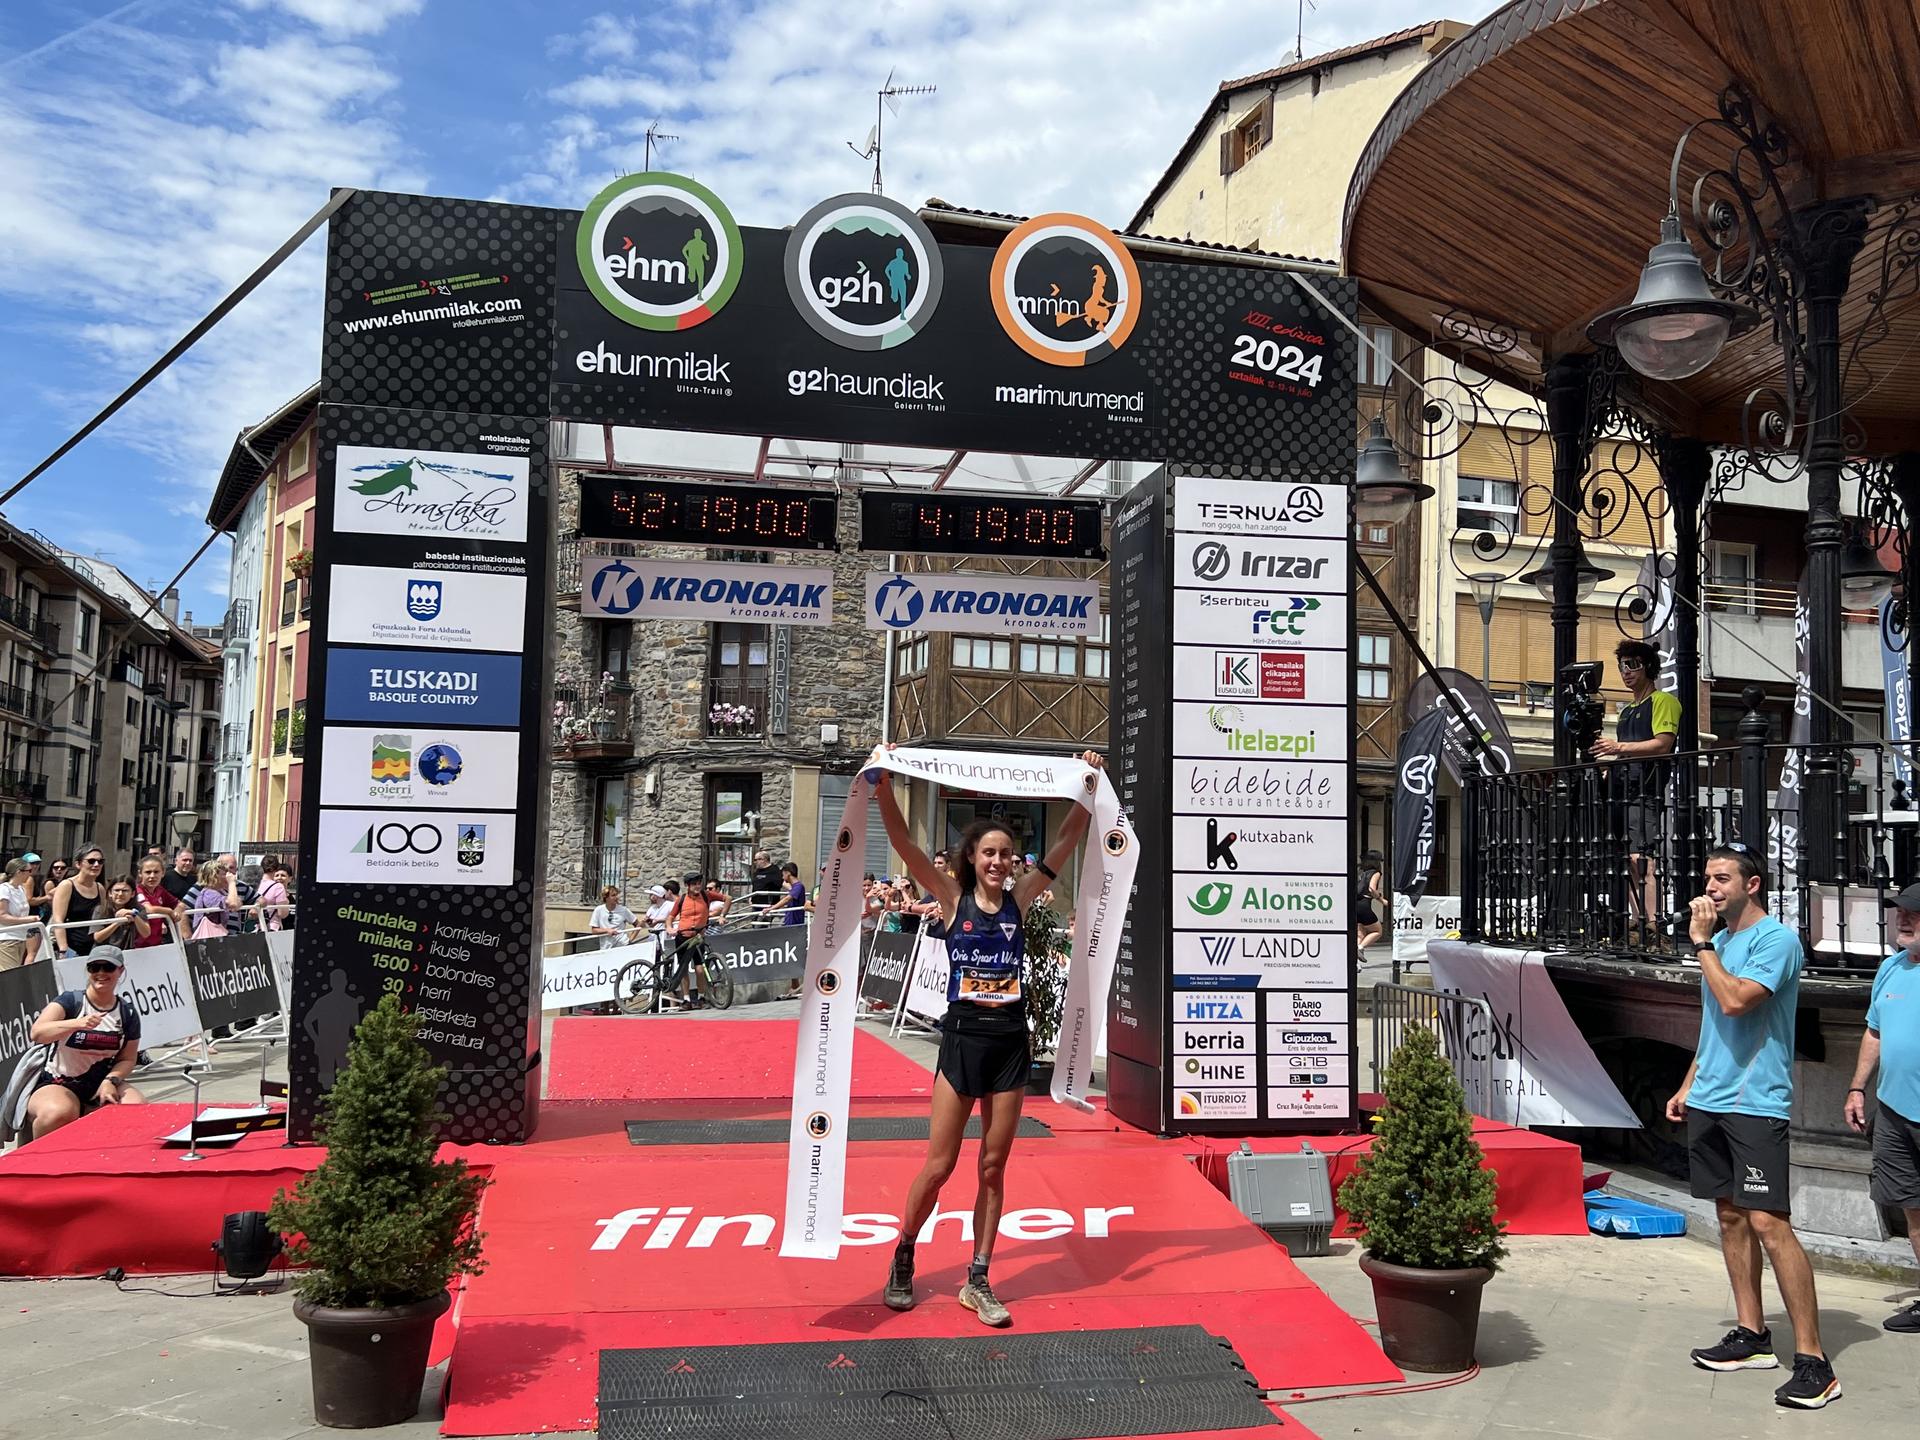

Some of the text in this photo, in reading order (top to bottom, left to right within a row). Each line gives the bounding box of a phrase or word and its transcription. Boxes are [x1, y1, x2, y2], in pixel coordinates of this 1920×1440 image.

[605, 246, 686, 284] ehm
[818, 270, 883, 308] g2h
[343, 298, 522, 333] www.ehunmilak.com
[1016, 295, 1080, 317] mmm
[452, 314, 524, 329] info@ehunmilak.com
[576, 340, 731, 384] ehunmilak
[1230, 335, 1322, 387] 2024
[787, 366, 944, 400] g2haundiak
[1229, 371, 1265, 386] uztailak
[927, 403, 945, 412] Trail
[995, 383, 1144, 412] marimurumendi
[1107, 414, 1143, 424] Marathon
[479, 434, 530, 444] antolatzailea
[487, 443, 530, 453] organizador
[364, 488, 516, 531] Arrastaka
[613, 490, 808, 537] 42:19:00
[1198, 503, 1291, 521] TERNUA
[920, 506, 1074, 544] 4:19:00
[1218, 522, 1242, 530] gogoa,
[1244, 523, 1259, 531] han
[413, 561, 526, 573] patrocinadores institucionales
[425, 552, 526, 564] babesle instituzionalak
[1241, 551, 1329, 579] Irizar
[650, 576, 828, 608] KRONOAK
[730, 607, 820, 619] kronoak.com
[929, 590, 1093, 618] KRONOAK
[372, 623, 416, 632] Gipuzkoako
[437, 627, 471, 635] Aldundia
[1004, 618, 1086, 629] kronoak.com
[1253, 610, 1306, 635] FCC
[372, 631, 410, 640] Diputación
[1262, 661, 1304, 669] Goi-mailako
[1265, 670, 1300, 679] elikagaiak
[370, 669, 478, 691] EUSKADI
[369, 692, 479, 706] BASQUE COUNTRY
[1227, 728, 1315, 757] itelazpi
[369, 784, 411, 796] goierri
[1190, 767, 1331, 795] bidebide
[1191, 797, 1331, 808] restaurante&bar
[362, 822, 442, 854] 100
[1240, 830, 1314, 843] kutxabank
[366, 859, 440, 868] Betidanik betiko
[824, 858, 841, 949] marimurumendi
[1241, 887, 1333, 911] Alonso
[337, 905, 417, 932] ehundaka
[1088, 871, 1114, 958] marimurumendi
[1393, 914, 1423, 929] erria
[358, 930, 414, 951] milaka
[434, 921, 501, 948] korrikalari
[429, 940, 471, 962] ikusle
[971, 949, 998, 966] Sport
[1242, 937, 1321, 958] LANDU
[371, 953, 410, 972] 1500
[868, 948, 906, 981] kutxabank
[195, 955, 271, 1000] kutxabank
[382, 977, 404, 993] 30
[425, 962, 496, 988] bolondres
[916, 958, 947, 994] kutxa
[122, 972, 185, 1016] abank
[419, 982, 452, 1002] herri
[414, 1003, 477, 1028] lasterketa
[1187, 1003, 1243, 1018] HITZA
[445, 1031, 485, 1050] natural
[1185, 1031, 1244, 1049] berria
[1284, 1033, 1328, 1044] Gipuzkoa
[815, 1002, 831, 1097] marimurumendi
[1065, 1007, 1085, 1095] marimurumendi
[1201, 1066, 1245, 1079] HINE
[1492, 1079, 1547, 1096] TRAIL
[1204, 1095, 1247, 1103] ITURRIOZ
[804, 1145, 822, 1243] marimurumendi
[589, 1206, 1135, 1251] finsher
